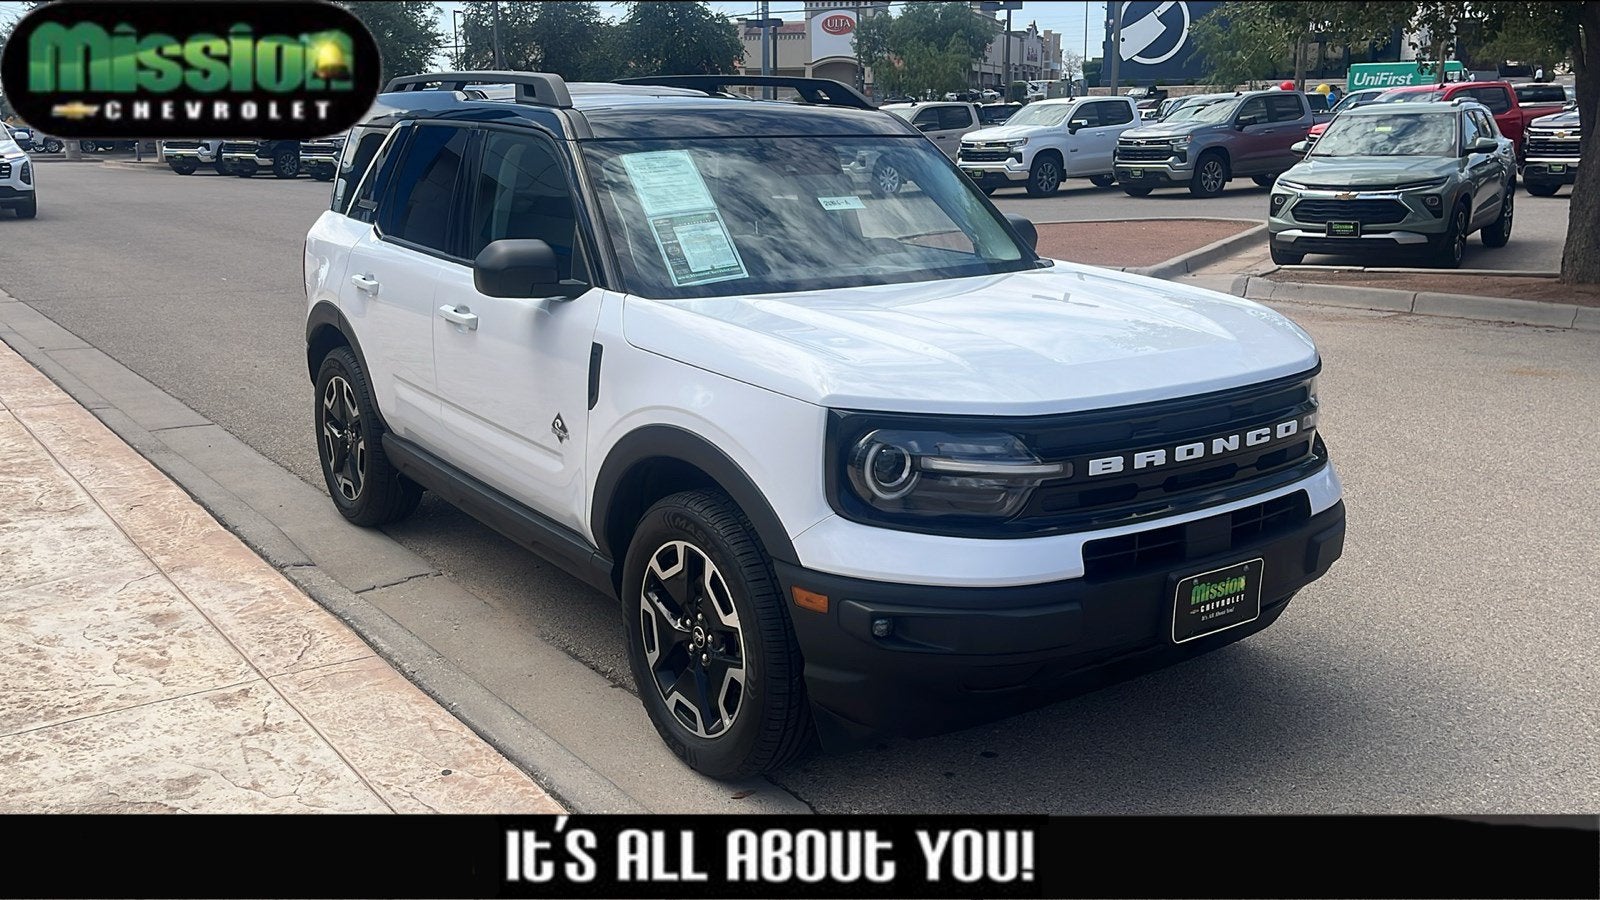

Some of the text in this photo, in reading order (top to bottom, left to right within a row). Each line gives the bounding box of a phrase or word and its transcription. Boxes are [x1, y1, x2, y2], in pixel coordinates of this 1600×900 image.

[828, 18, 851, 28] ULTA
[1353, 72, 1413, 86] UniFirst
[1088, 419, 1298, 476] BRONCO
[1191, 574, 1246, 605] Mission
[1200, 594, 1246, 613] CHEVROLET
